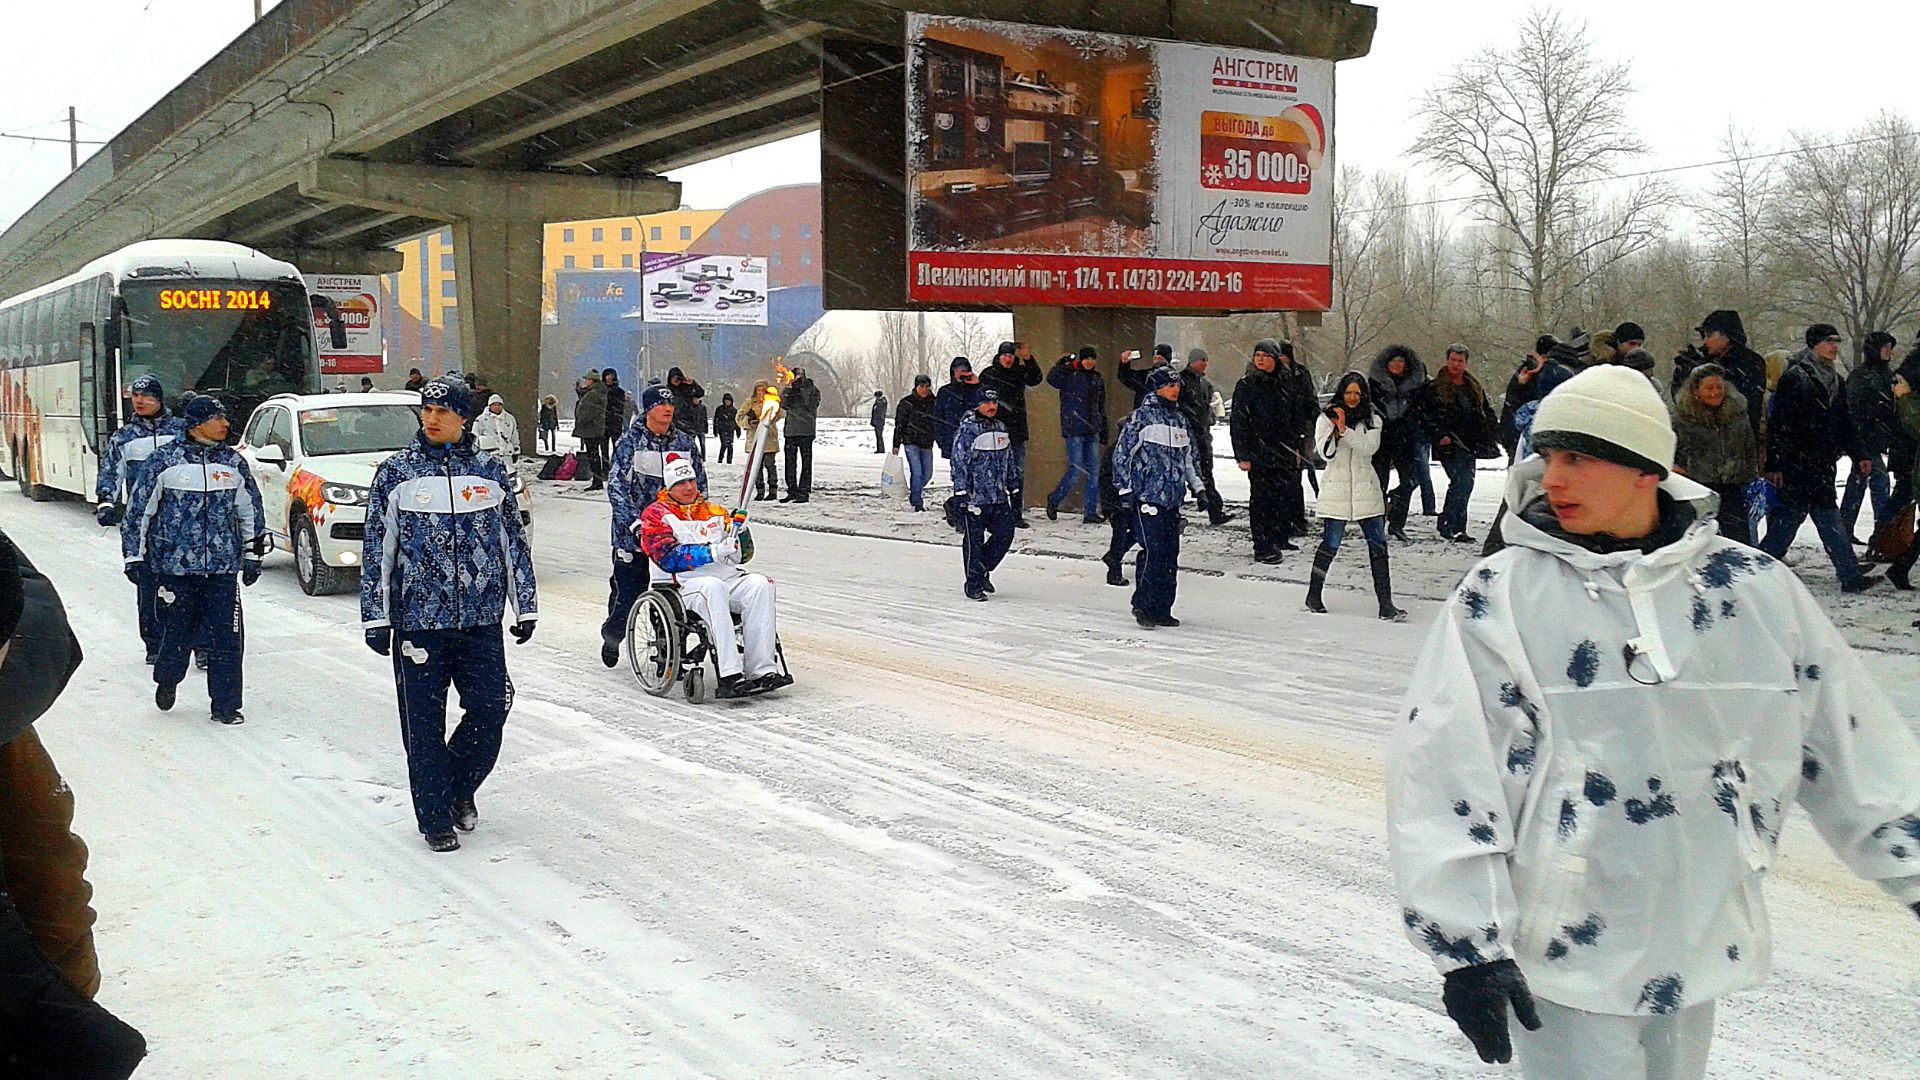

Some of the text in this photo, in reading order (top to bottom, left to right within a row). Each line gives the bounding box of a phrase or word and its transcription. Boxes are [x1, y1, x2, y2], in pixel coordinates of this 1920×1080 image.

[1212, 56, 1298, 83] АНГСТРЕМ
[1214, 118, 1260, 136] ВЫГОДА
[1224, 148, 1252, 180] 35
[1230, 198, 1309, 212] -30% на коллекцию
[1195, 198, 1284, 246] Адажио
[917, 262, 1242, 293] Ленинский пр-т, 174, т. (473) 224-20-16
[160, 289, 271, 310] SOCHI 2014
